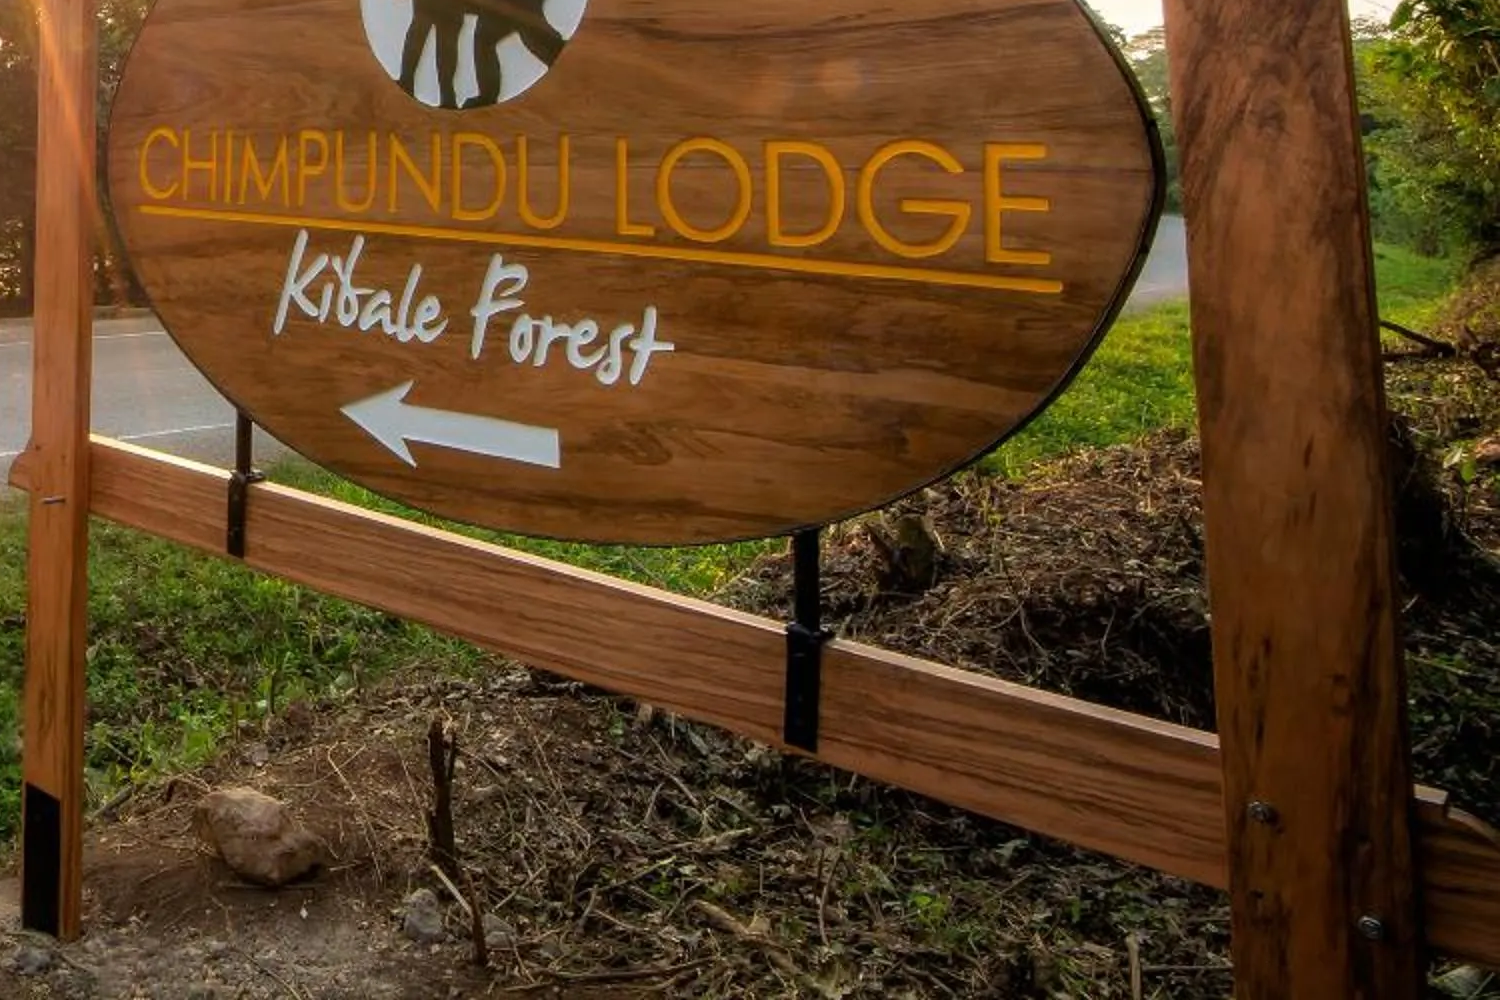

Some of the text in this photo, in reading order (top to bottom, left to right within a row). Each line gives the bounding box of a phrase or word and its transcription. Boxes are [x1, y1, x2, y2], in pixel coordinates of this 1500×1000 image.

[139, 127, 1052, 265] CHIMPUNDU LODGE
[274, 229, 675, 386] Kibale Forest
